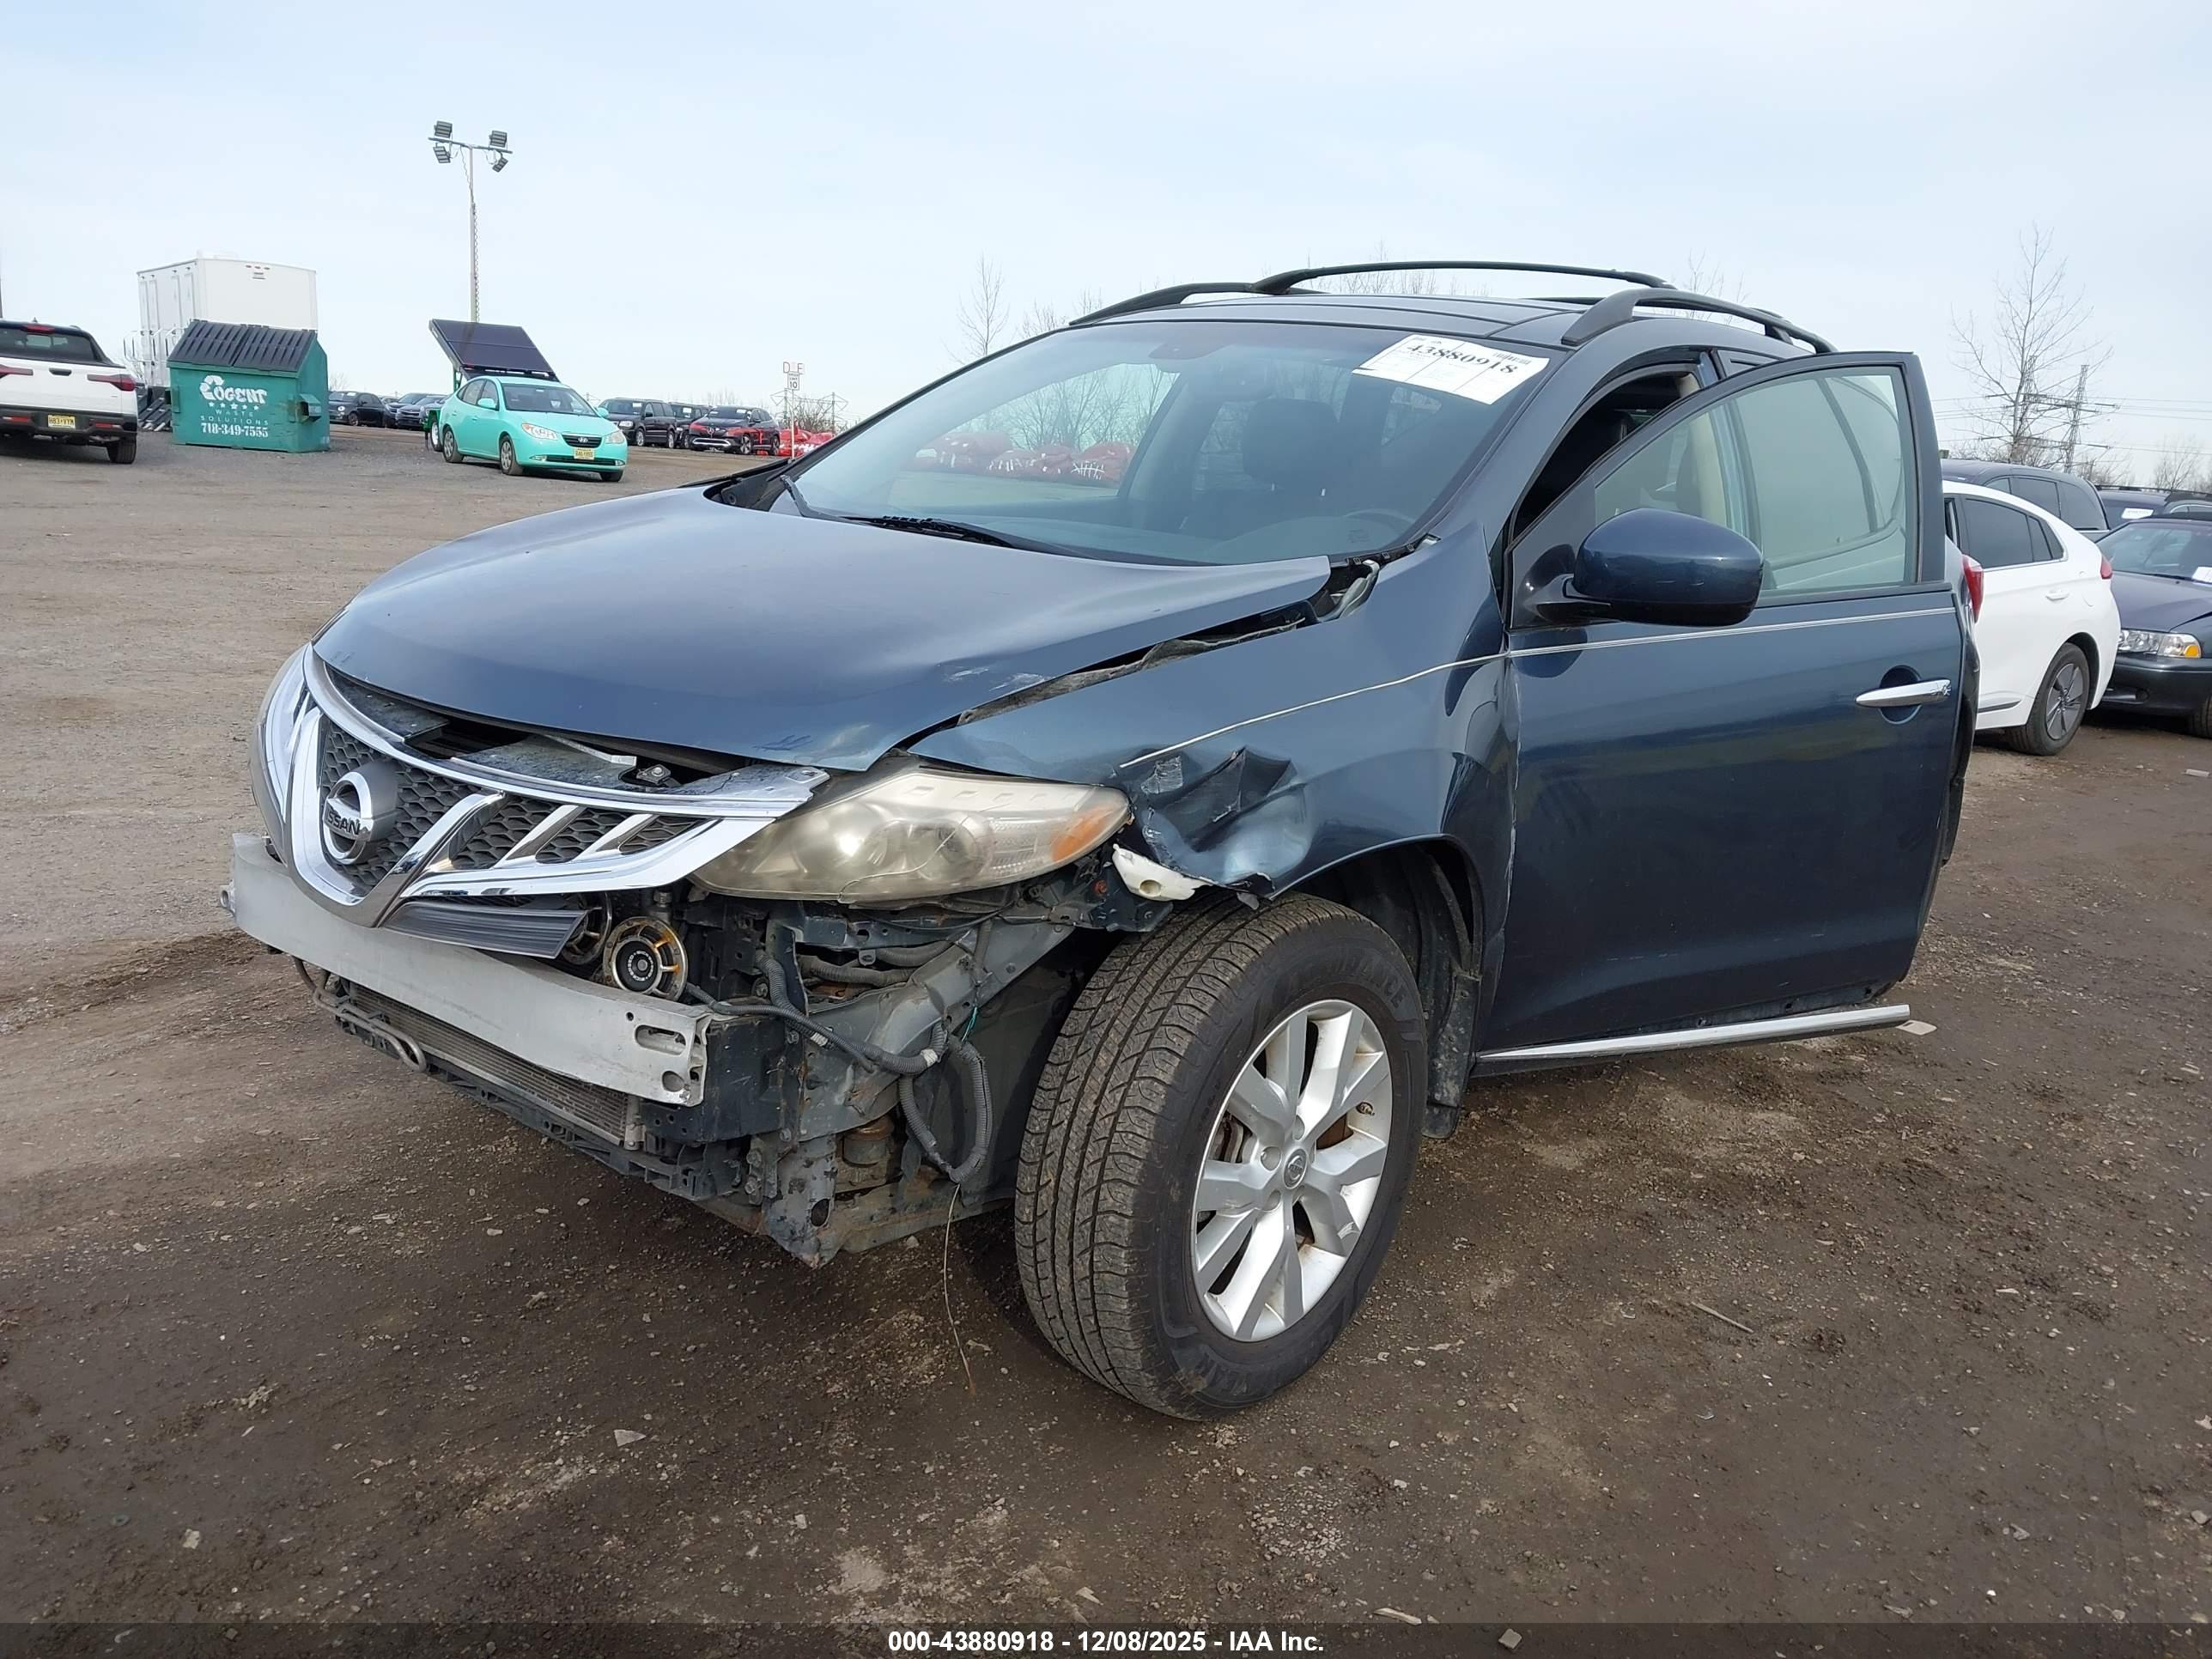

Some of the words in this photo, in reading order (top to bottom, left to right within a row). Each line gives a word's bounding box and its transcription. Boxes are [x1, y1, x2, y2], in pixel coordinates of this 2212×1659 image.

[1407, 344, 1518, 374] 43880918
[216, 409, 253, 417] WASTE
[200, 416, 269, 425] SOLUTIONS
[200, 422, 269, 438] 718-349-7555
